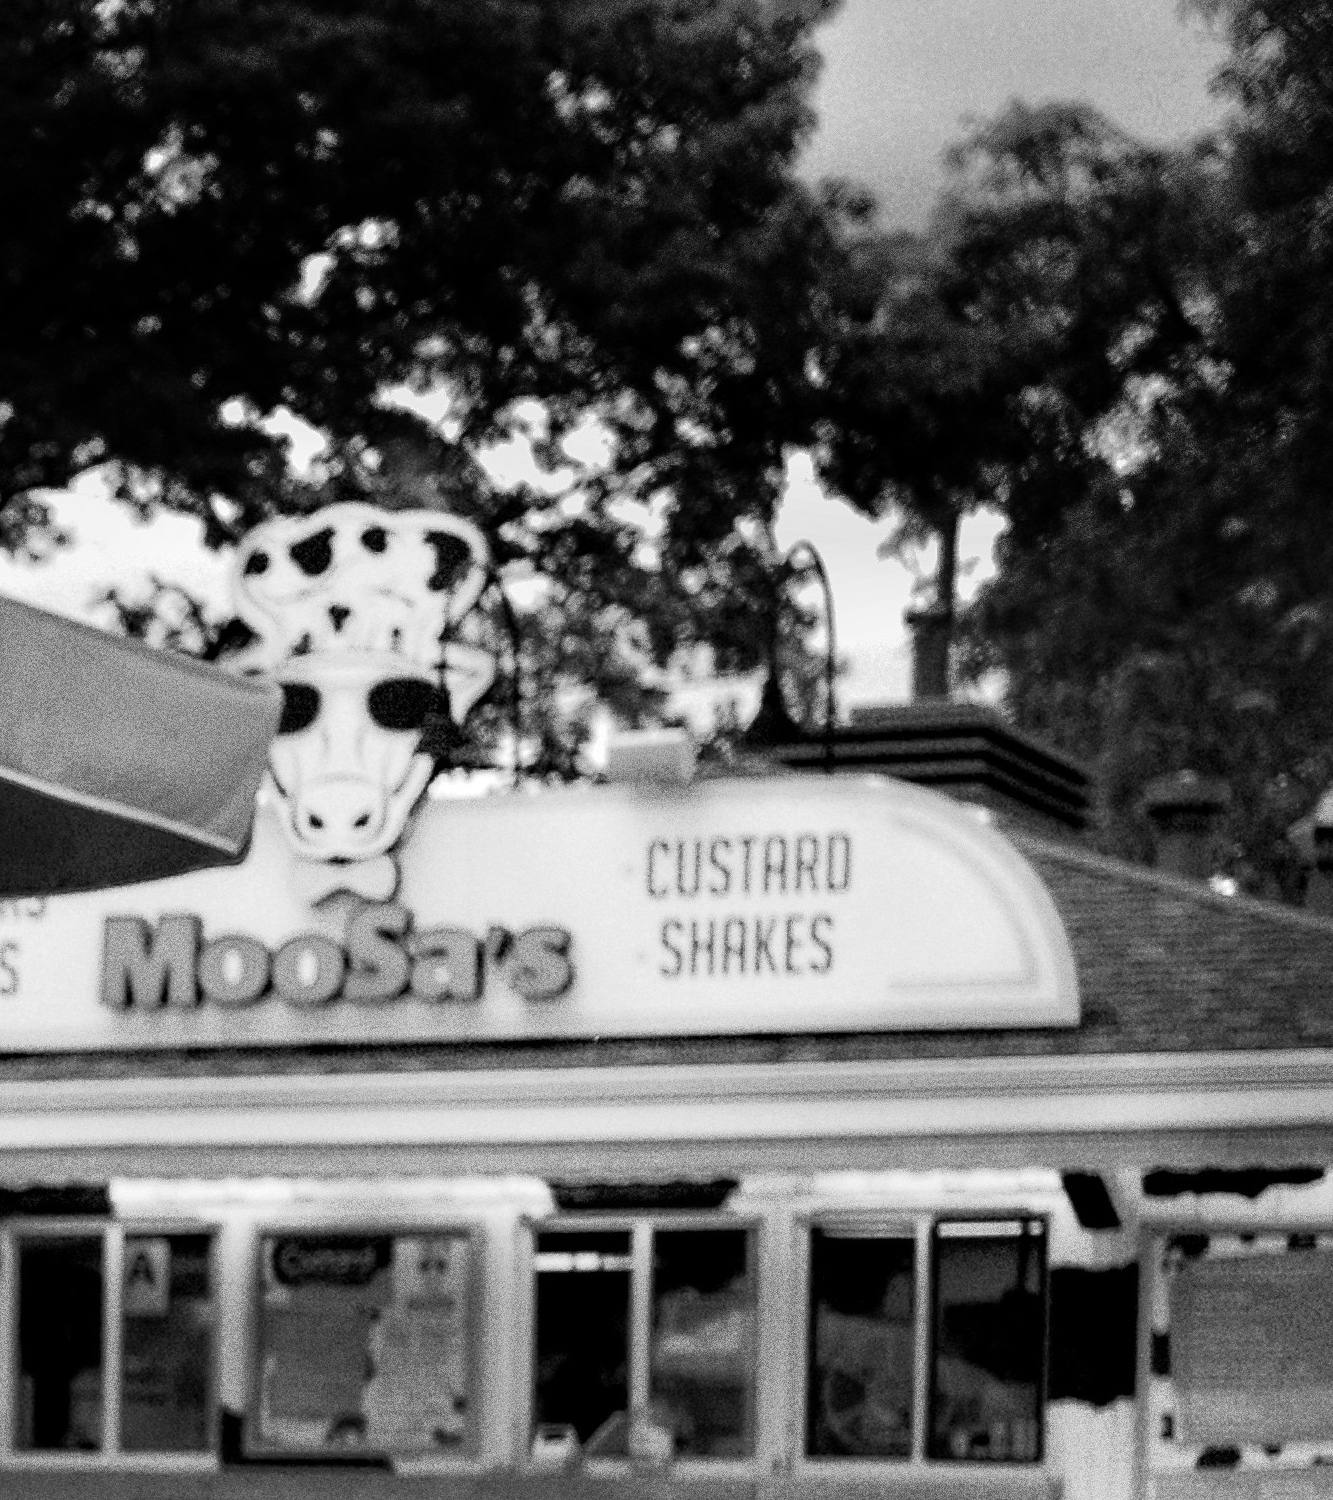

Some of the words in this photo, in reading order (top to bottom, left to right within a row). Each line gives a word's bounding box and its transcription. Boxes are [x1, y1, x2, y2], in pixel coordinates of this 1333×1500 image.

[645, 832, 852, 897] CUSTARD
[100, 902, 573, 1010] MooSa's
[658, 913, 834, 975] SHAKES
